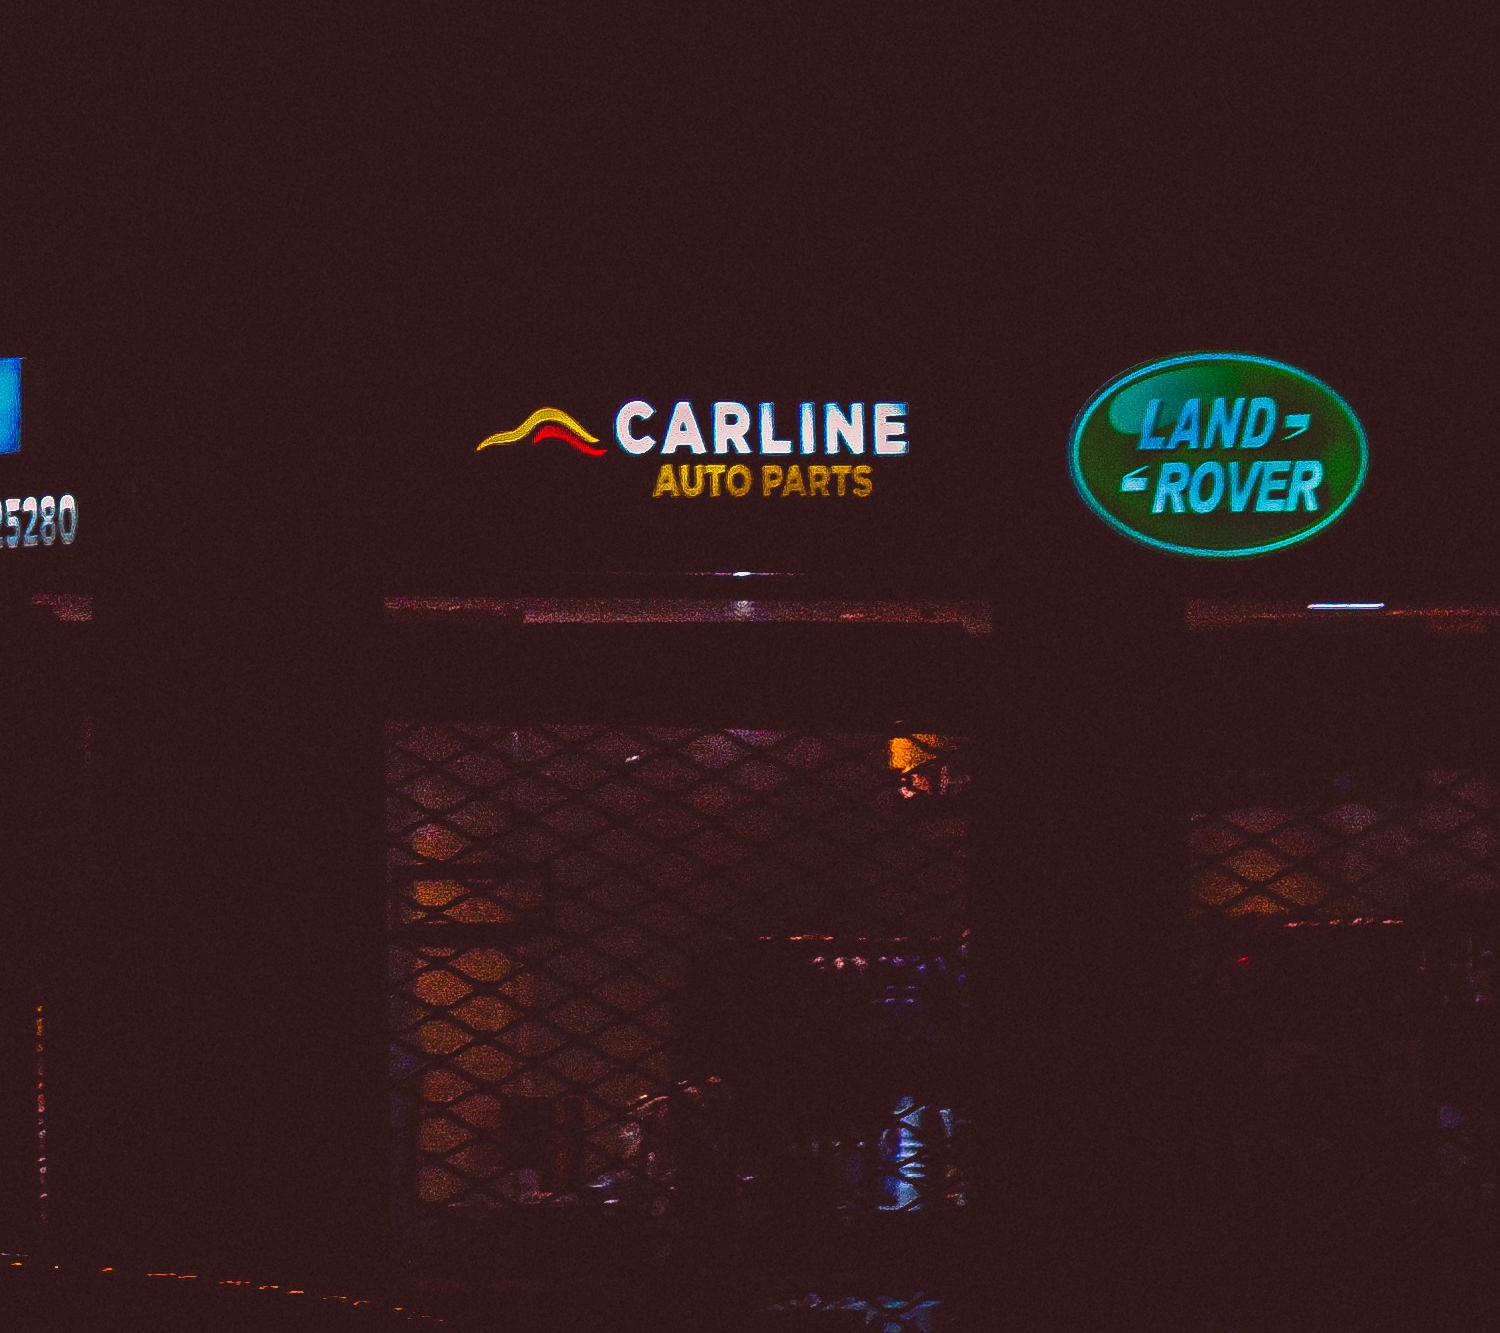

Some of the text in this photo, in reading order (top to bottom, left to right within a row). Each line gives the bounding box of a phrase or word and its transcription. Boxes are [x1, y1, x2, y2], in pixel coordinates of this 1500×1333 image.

[613, 398, 910, 456] CARLINE
[1138, 396, 1278, 450] LAND
[652, 462, 874, 498] AUTO PARTS
[1151, 459, 1324, 515] ROVER
